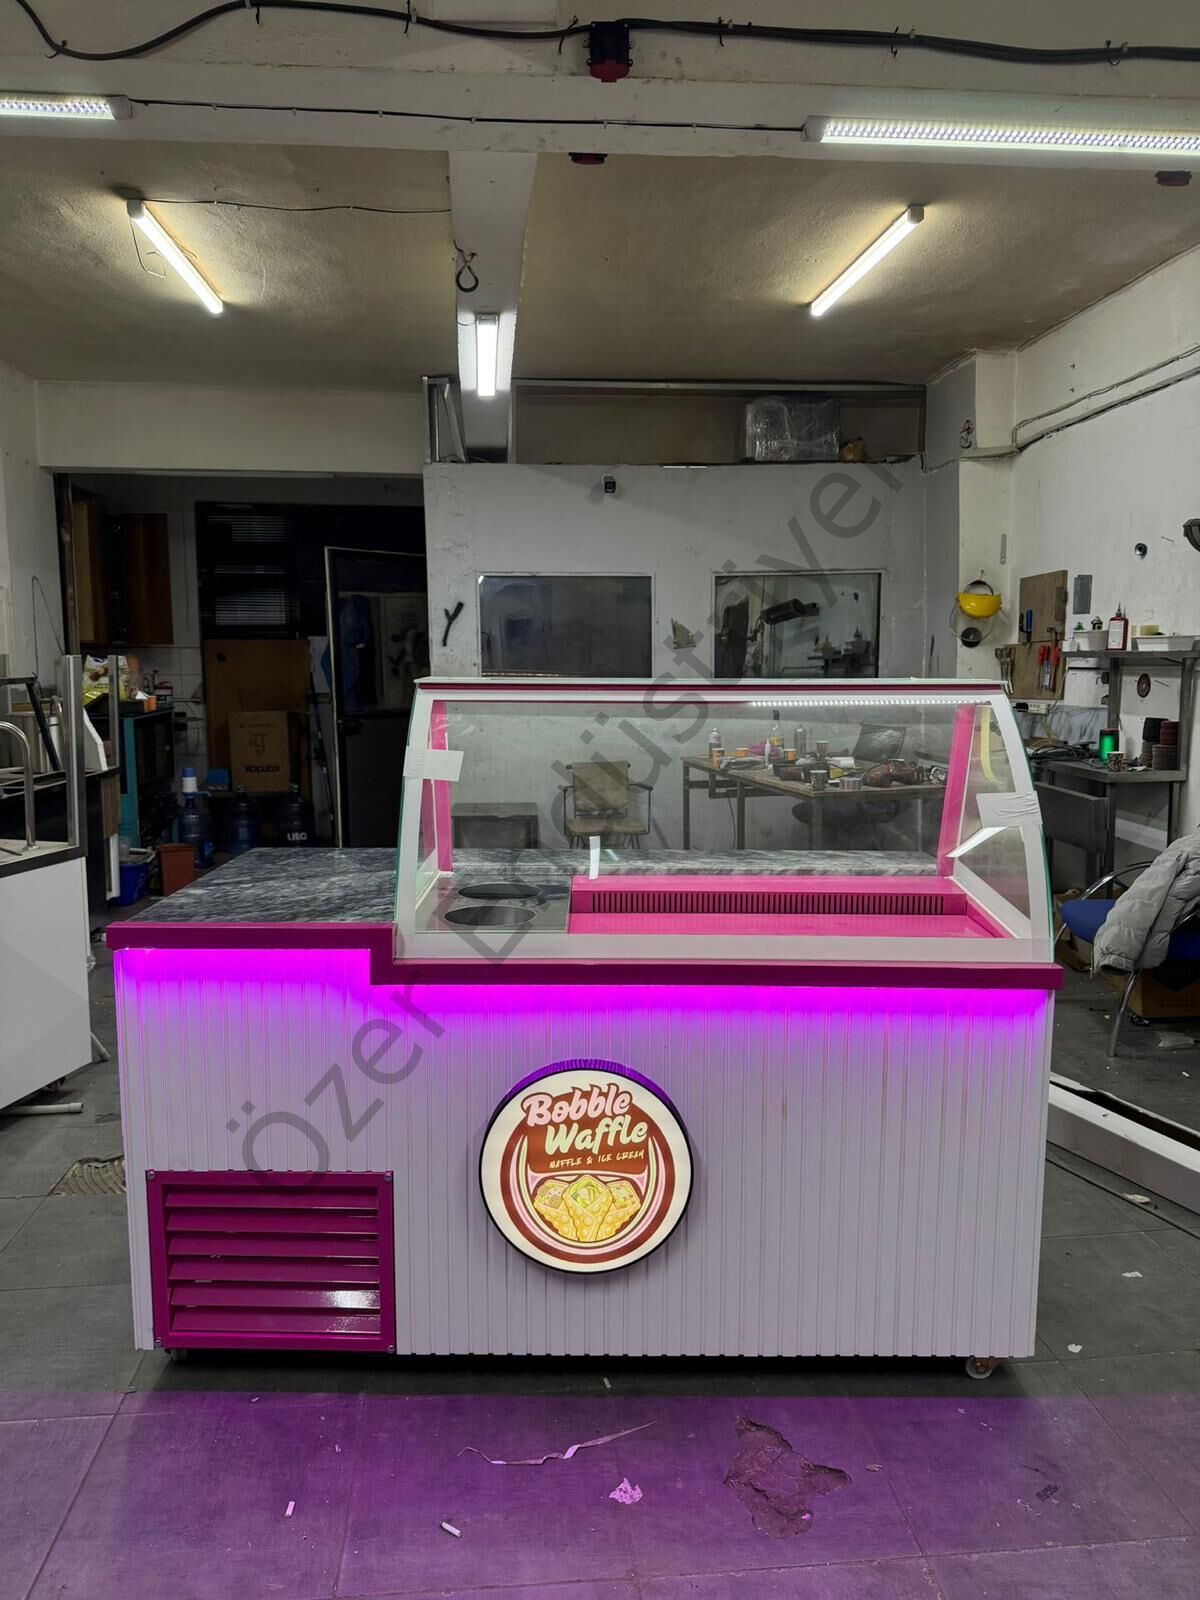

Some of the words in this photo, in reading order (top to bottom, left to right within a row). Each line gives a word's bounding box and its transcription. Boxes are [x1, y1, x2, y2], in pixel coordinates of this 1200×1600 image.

[521, 1084, 632, 1127] Bobble
[544, 1115, 648, 1155] Waffle
[549, 1157, 582, 1169] WAFFLE
[598, 1153, 612, 1163] ICE
[616, 1149, 645, 1161] CREAM
